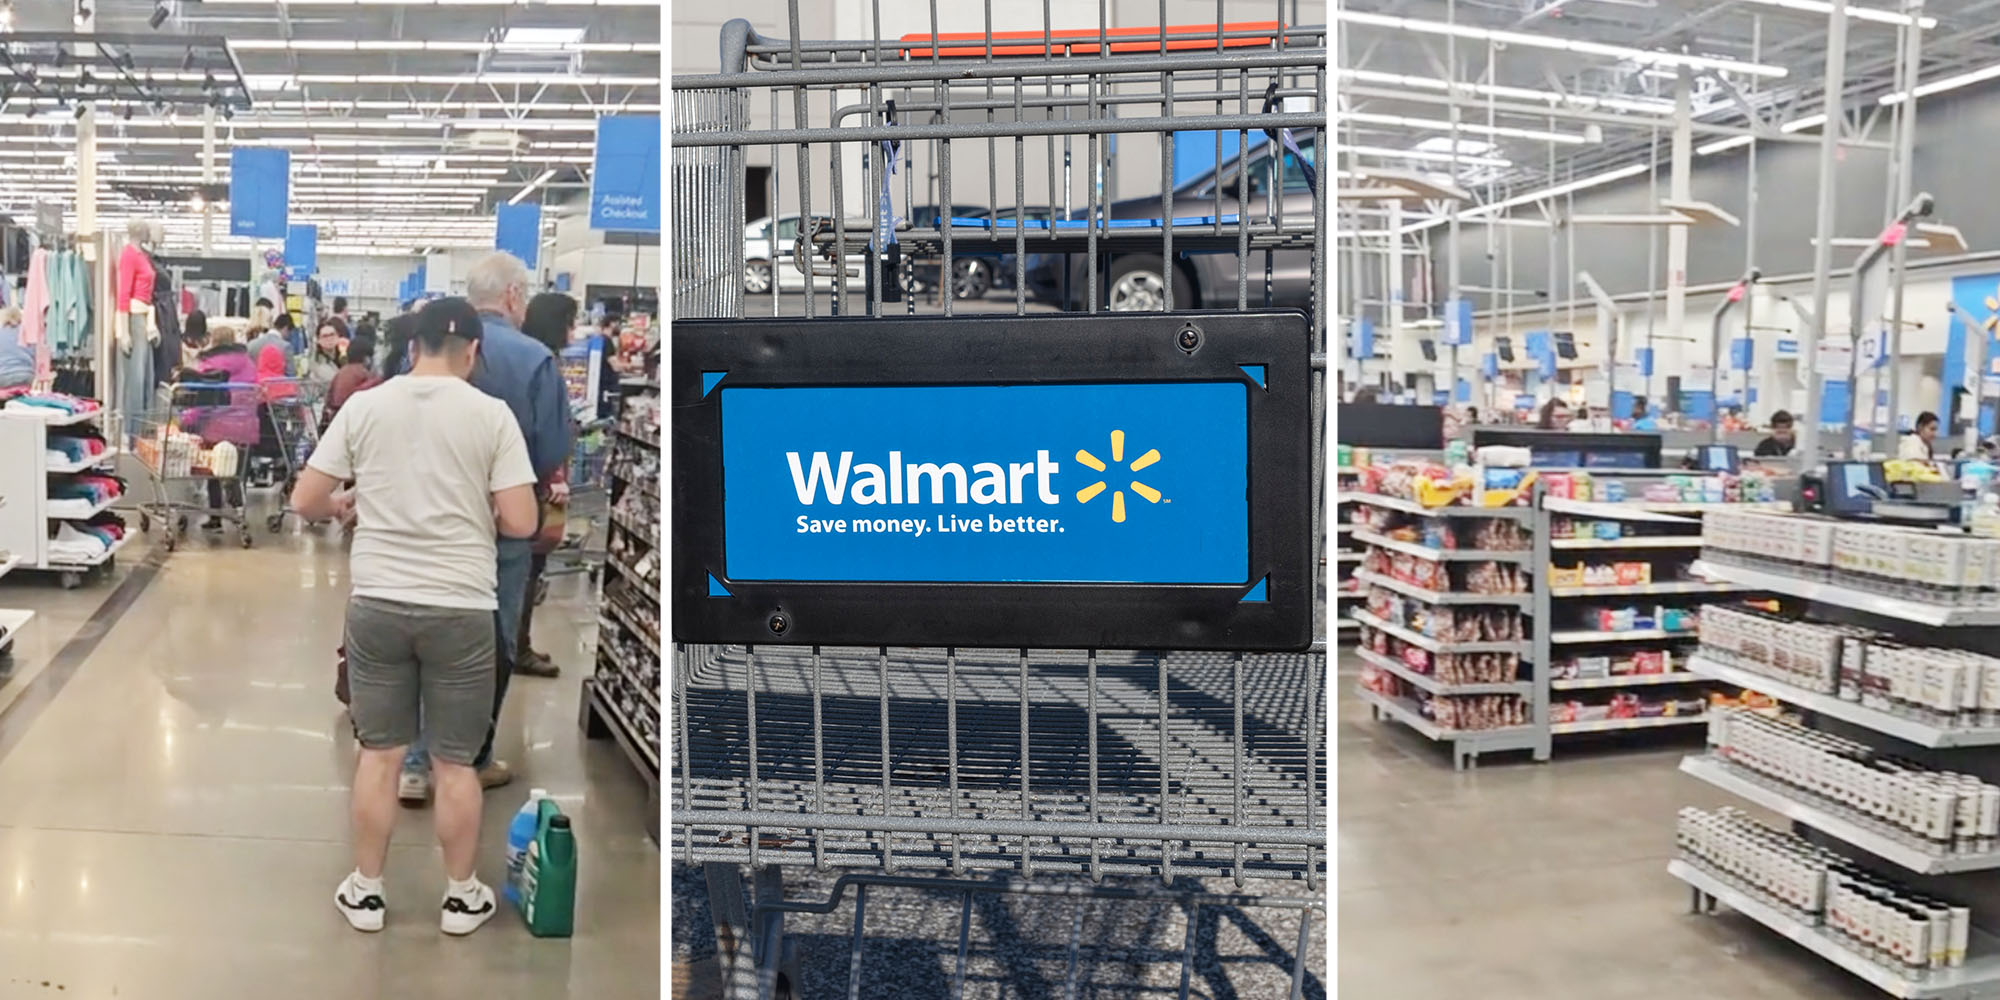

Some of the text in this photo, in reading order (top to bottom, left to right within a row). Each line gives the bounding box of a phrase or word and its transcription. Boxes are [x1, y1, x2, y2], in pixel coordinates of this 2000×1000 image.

[785, 449, 1060, 505] Walmart
[796, 513, 1065, 537] Save money. Live better.
